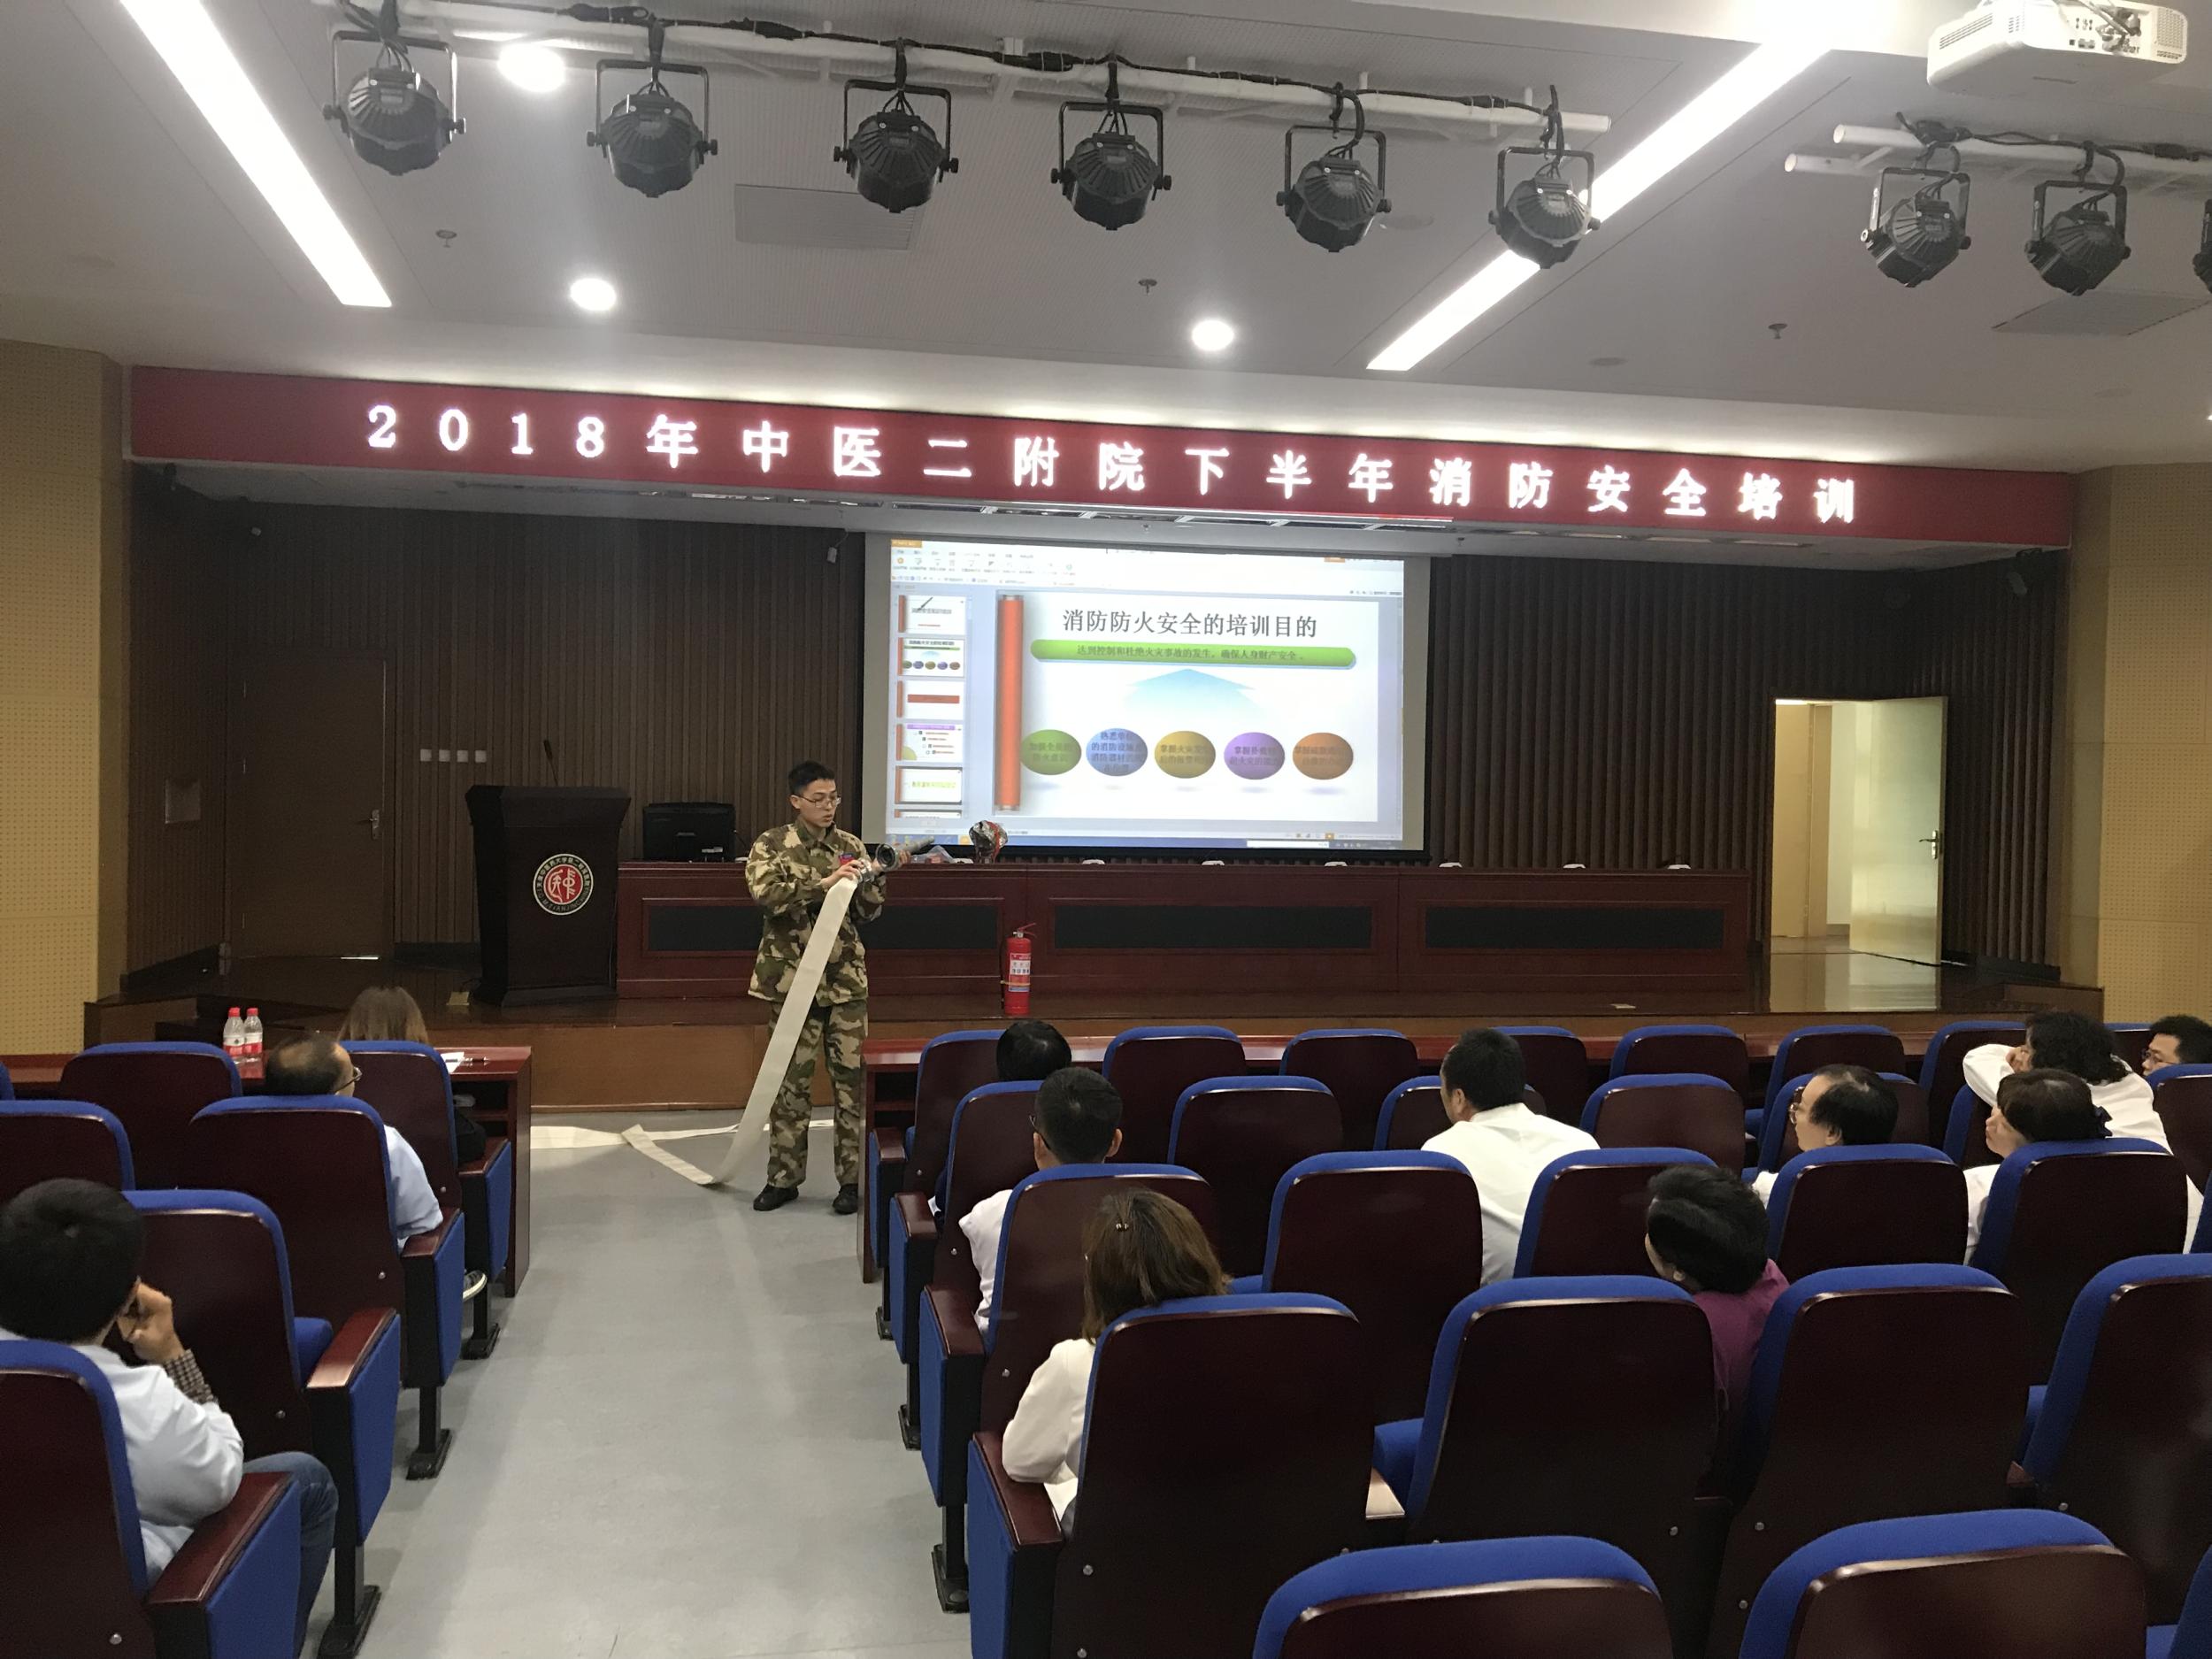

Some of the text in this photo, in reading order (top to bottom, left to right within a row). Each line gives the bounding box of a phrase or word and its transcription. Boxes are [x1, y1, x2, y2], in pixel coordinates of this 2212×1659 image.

[366, 403, 1856, 525] 2018年中医二附院下半年消防安全培训
[1063, 609, 1317, 638] 消防防火安全的培训目的
